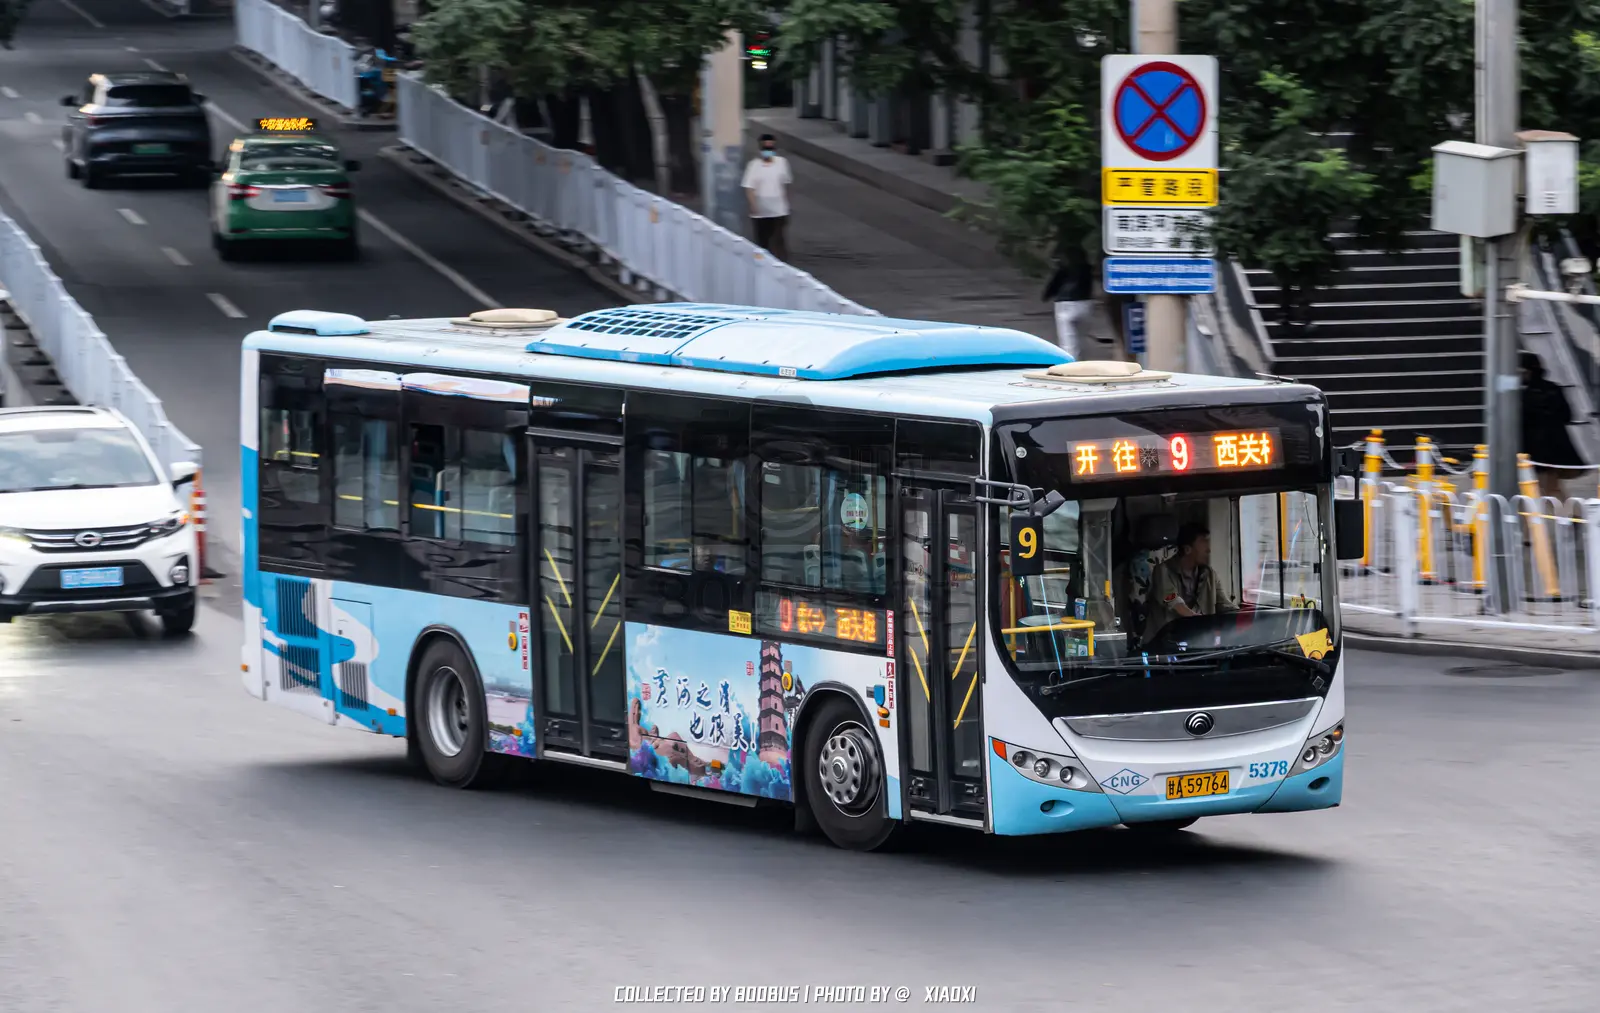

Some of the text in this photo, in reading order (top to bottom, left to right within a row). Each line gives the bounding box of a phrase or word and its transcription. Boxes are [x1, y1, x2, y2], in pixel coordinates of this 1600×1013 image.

[1170, 436, 1188, 470] 9
[1018, 527, 1037, 558] 9
[1111, 775, 1140, 788] CNG
[1249, 760, 1288, 779] 5378
